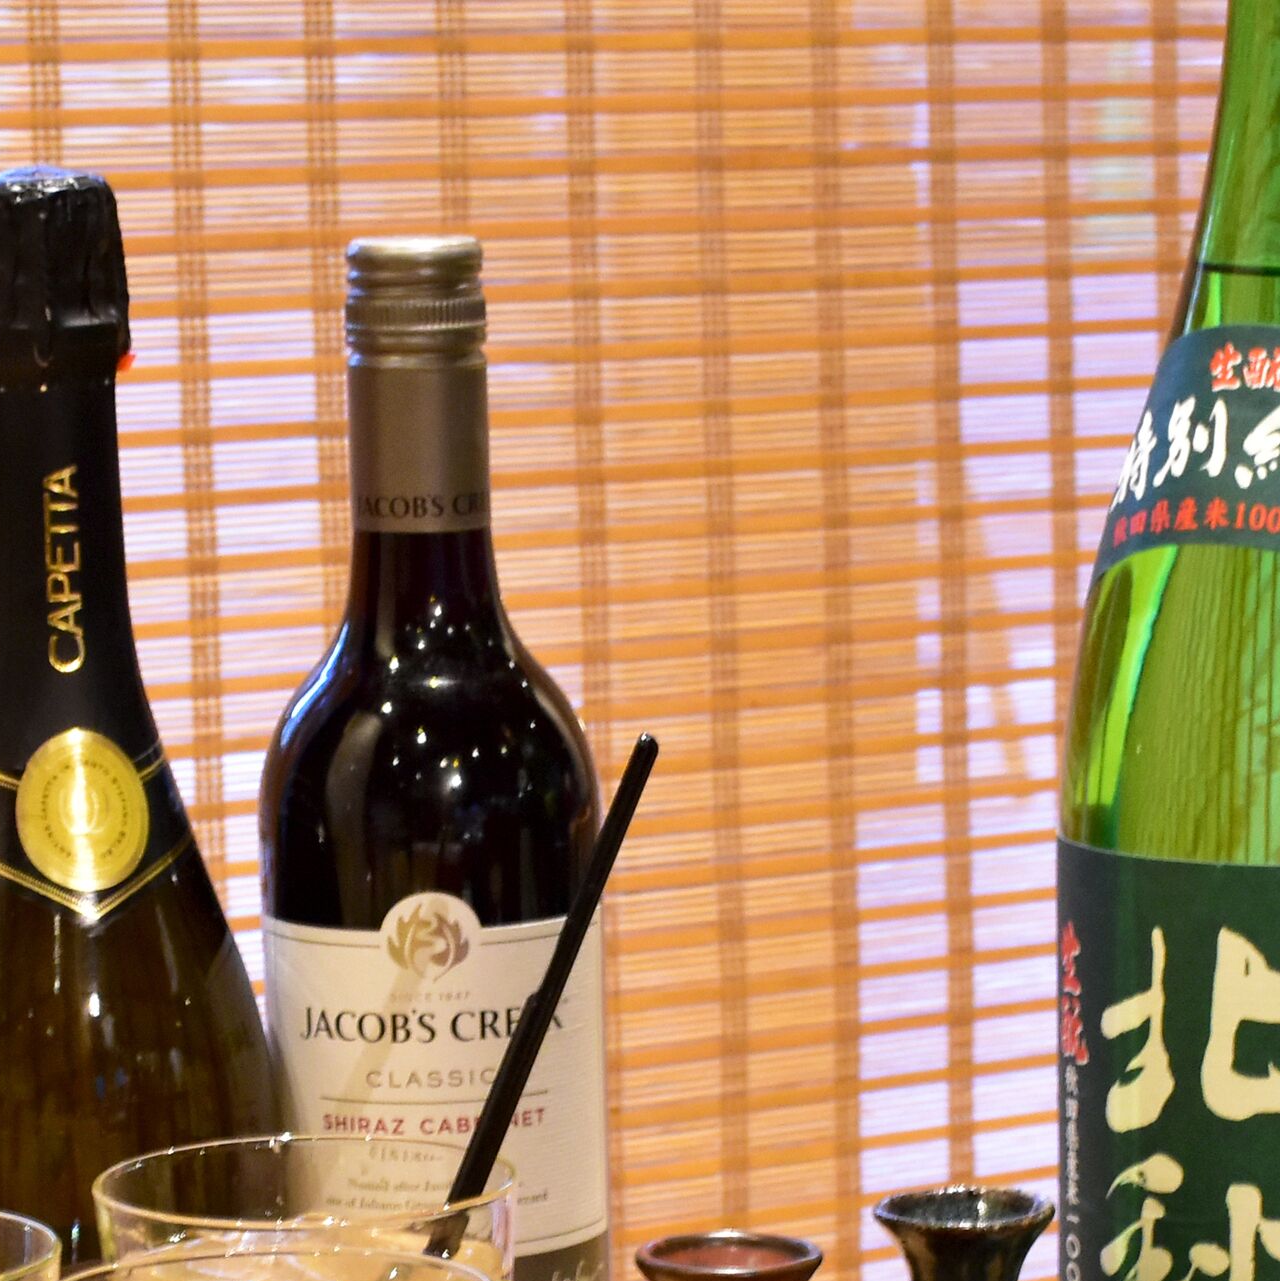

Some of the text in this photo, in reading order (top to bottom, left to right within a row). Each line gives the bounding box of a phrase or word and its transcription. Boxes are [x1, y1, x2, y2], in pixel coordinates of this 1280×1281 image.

[42, 463, 86, 674] CAPETTA
[300, 1007, 564, 1044] JACOB'S CRE
[365, 1068, 498, 1089] CLASSIC
[323, 1114, 405, 1136] SHIRAZ
